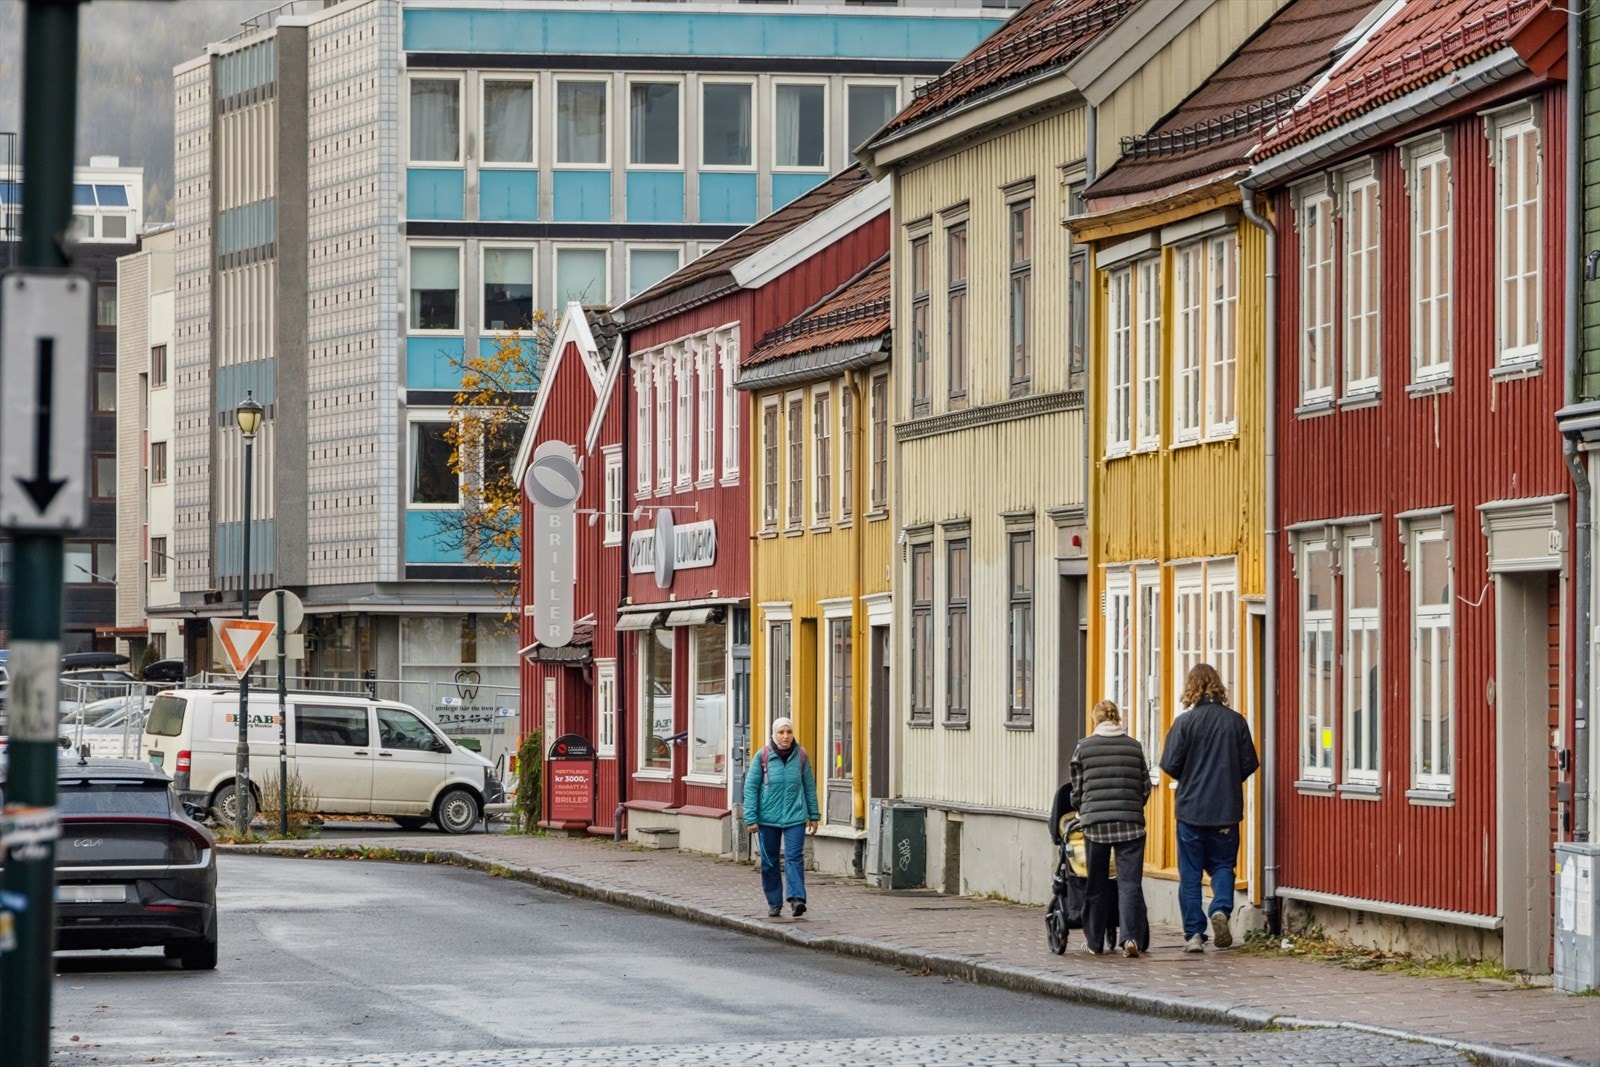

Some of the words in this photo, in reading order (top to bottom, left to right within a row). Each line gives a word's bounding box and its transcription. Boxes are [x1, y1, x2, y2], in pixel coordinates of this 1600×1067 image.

[676, 528, 713, 562] LUNDEMO
[548, 514, 562, 638] BRILLER
[565, 775, 589, 783] 3000,-
[555, 796, 588, 804] BRILLER
